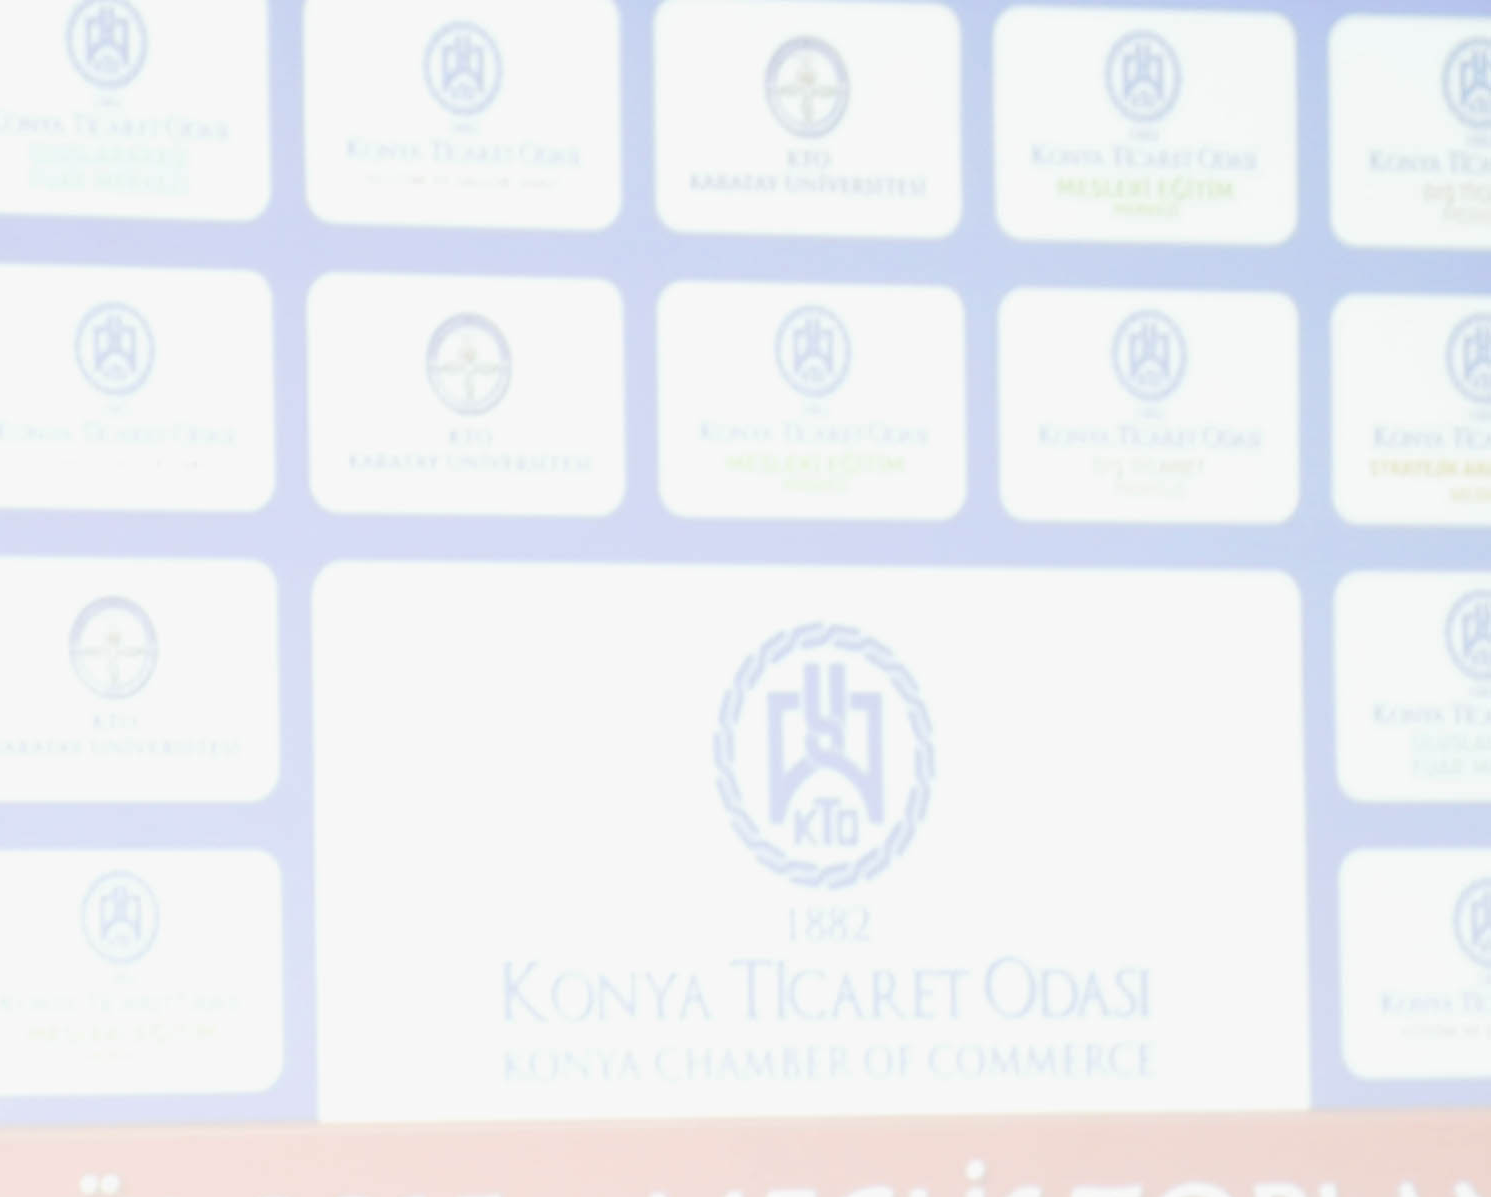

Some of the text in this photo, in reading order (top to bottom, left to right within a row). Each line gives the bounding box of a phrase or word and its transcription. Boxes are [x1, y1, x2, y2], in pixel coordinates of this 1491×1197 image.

[792, 796, 860, 848] KTO
[788, 905, 871, 943] 1882
[501, 959, 718, 1023] KONYA
[983, 953, 1154, 1023] ODASI
[501, 1040, 1157, 1081] KONYA CHAMBER OF COMMERCE
